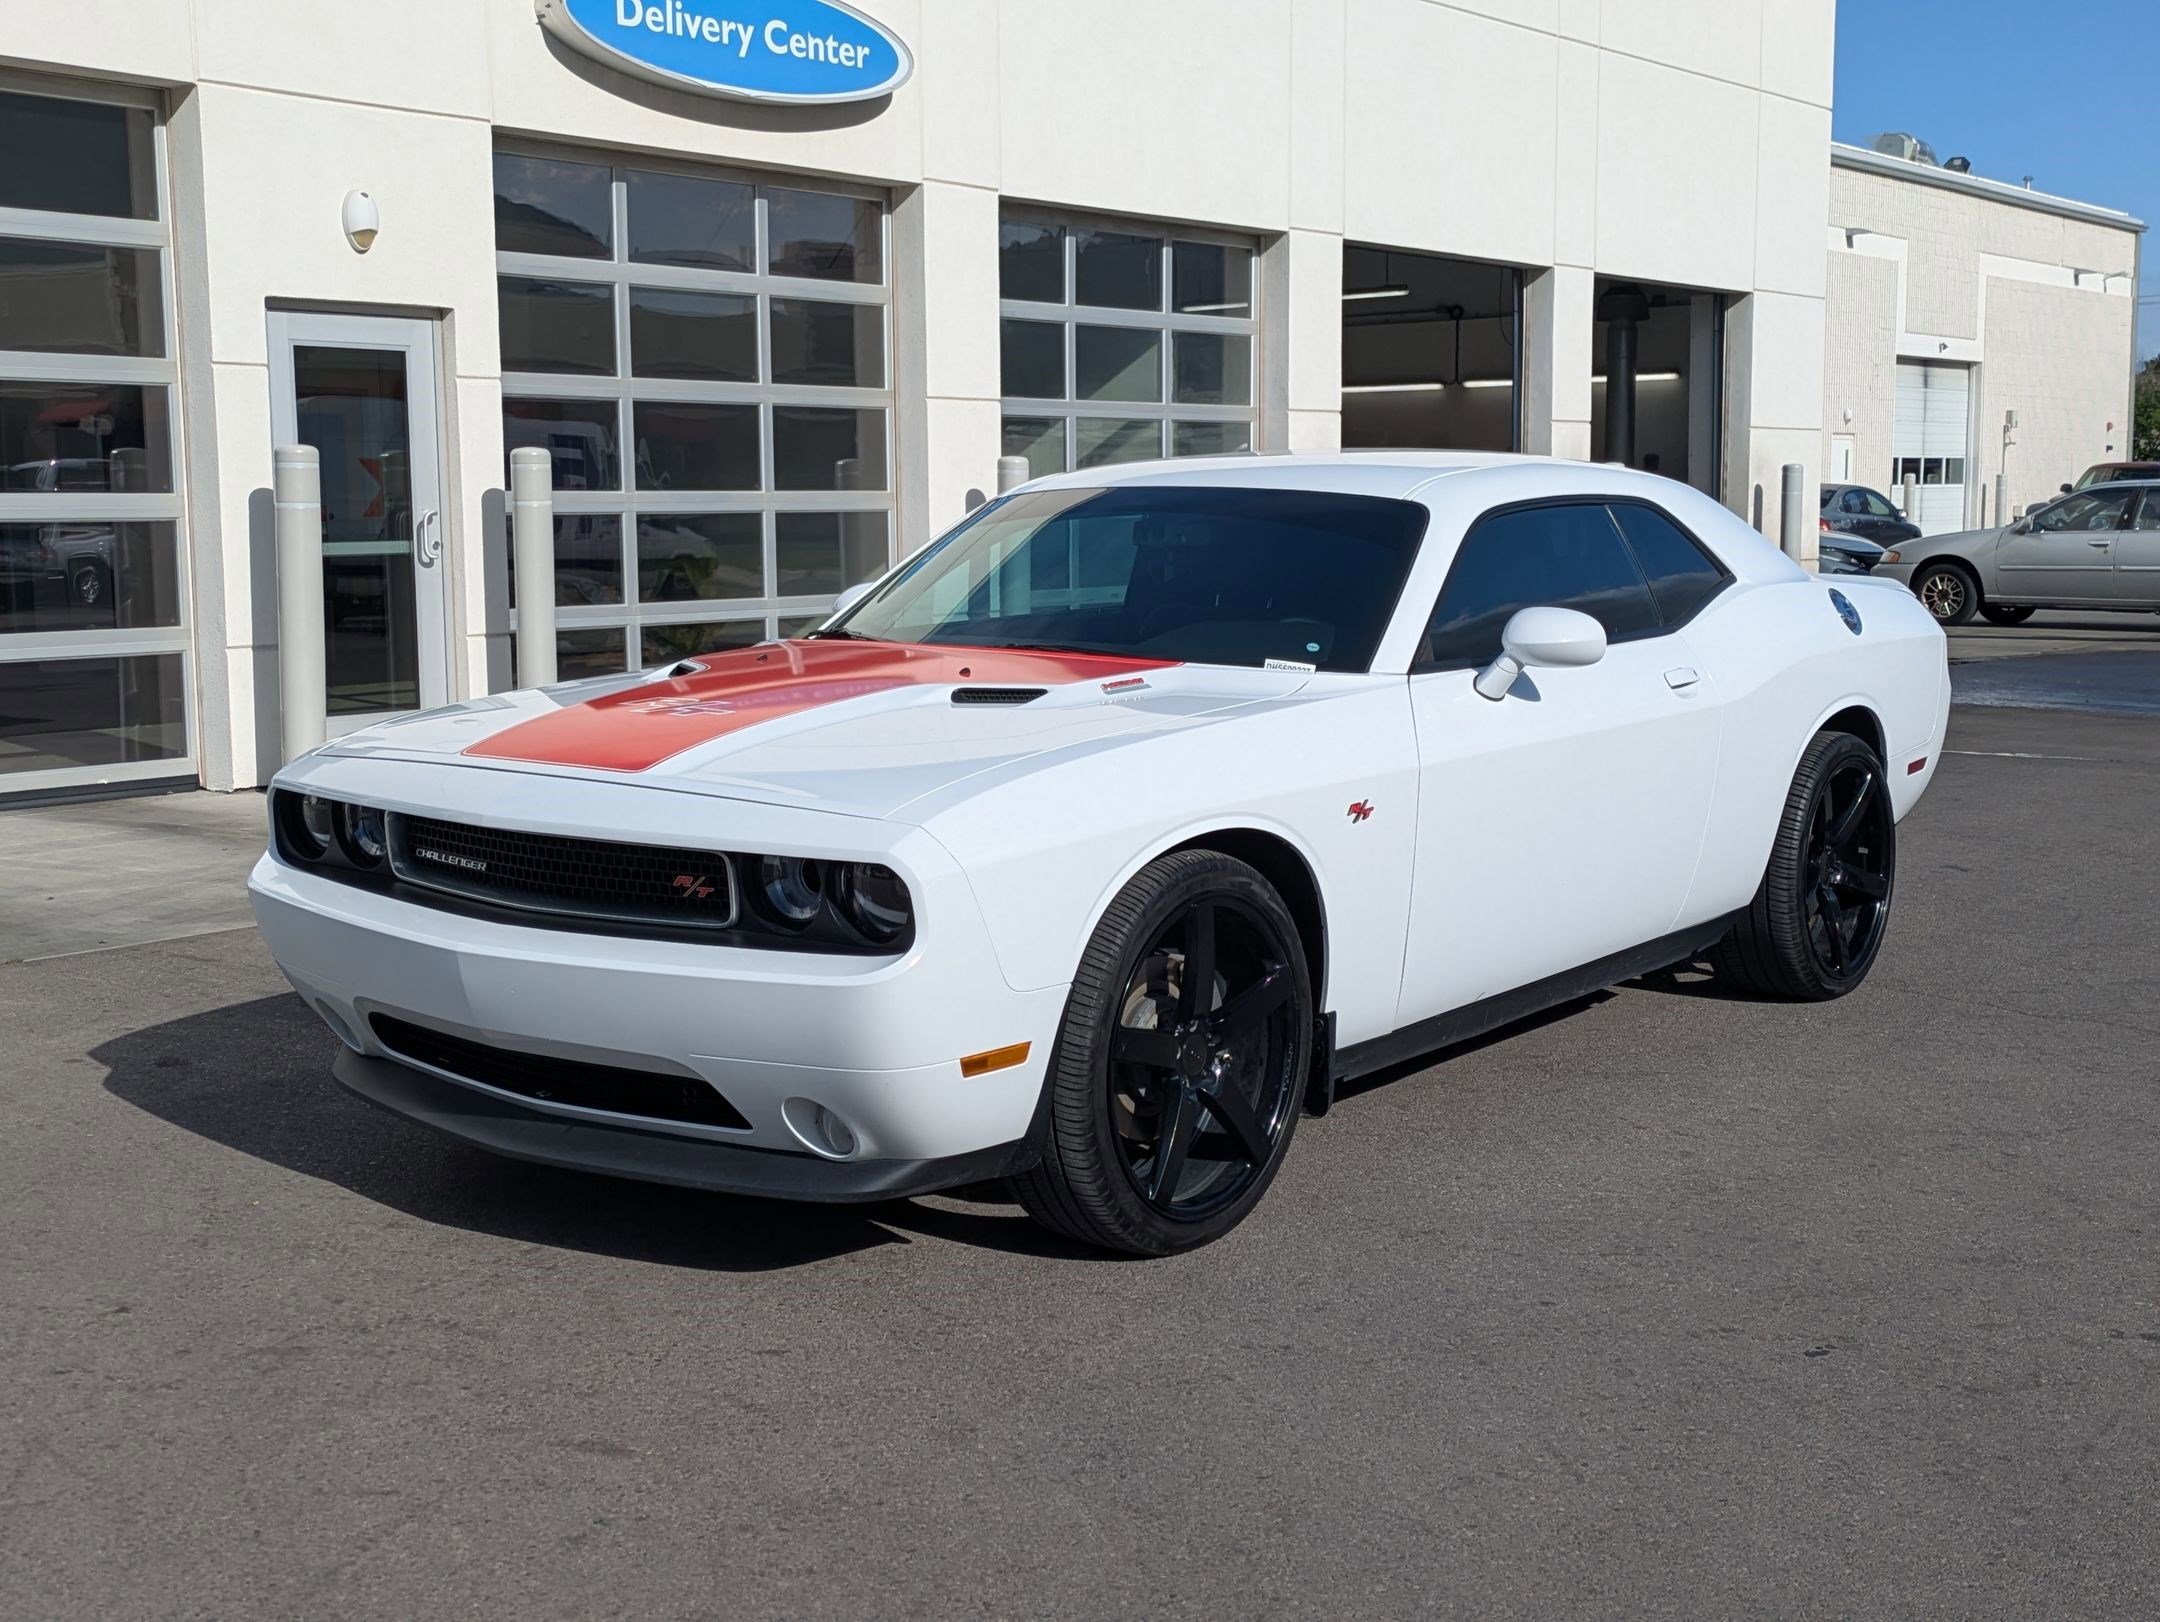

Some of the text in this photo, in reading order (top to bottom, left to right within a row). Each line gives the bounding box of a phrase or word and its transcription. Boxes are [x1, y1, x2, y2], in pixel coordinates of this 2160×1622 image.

[616, 0, 871, 69] Delivery Center
[1347, 799, 1375, 825] R/T
[415, 848, 488, 872] CHALLENGER
[672, 875, 715, 898] R/T
